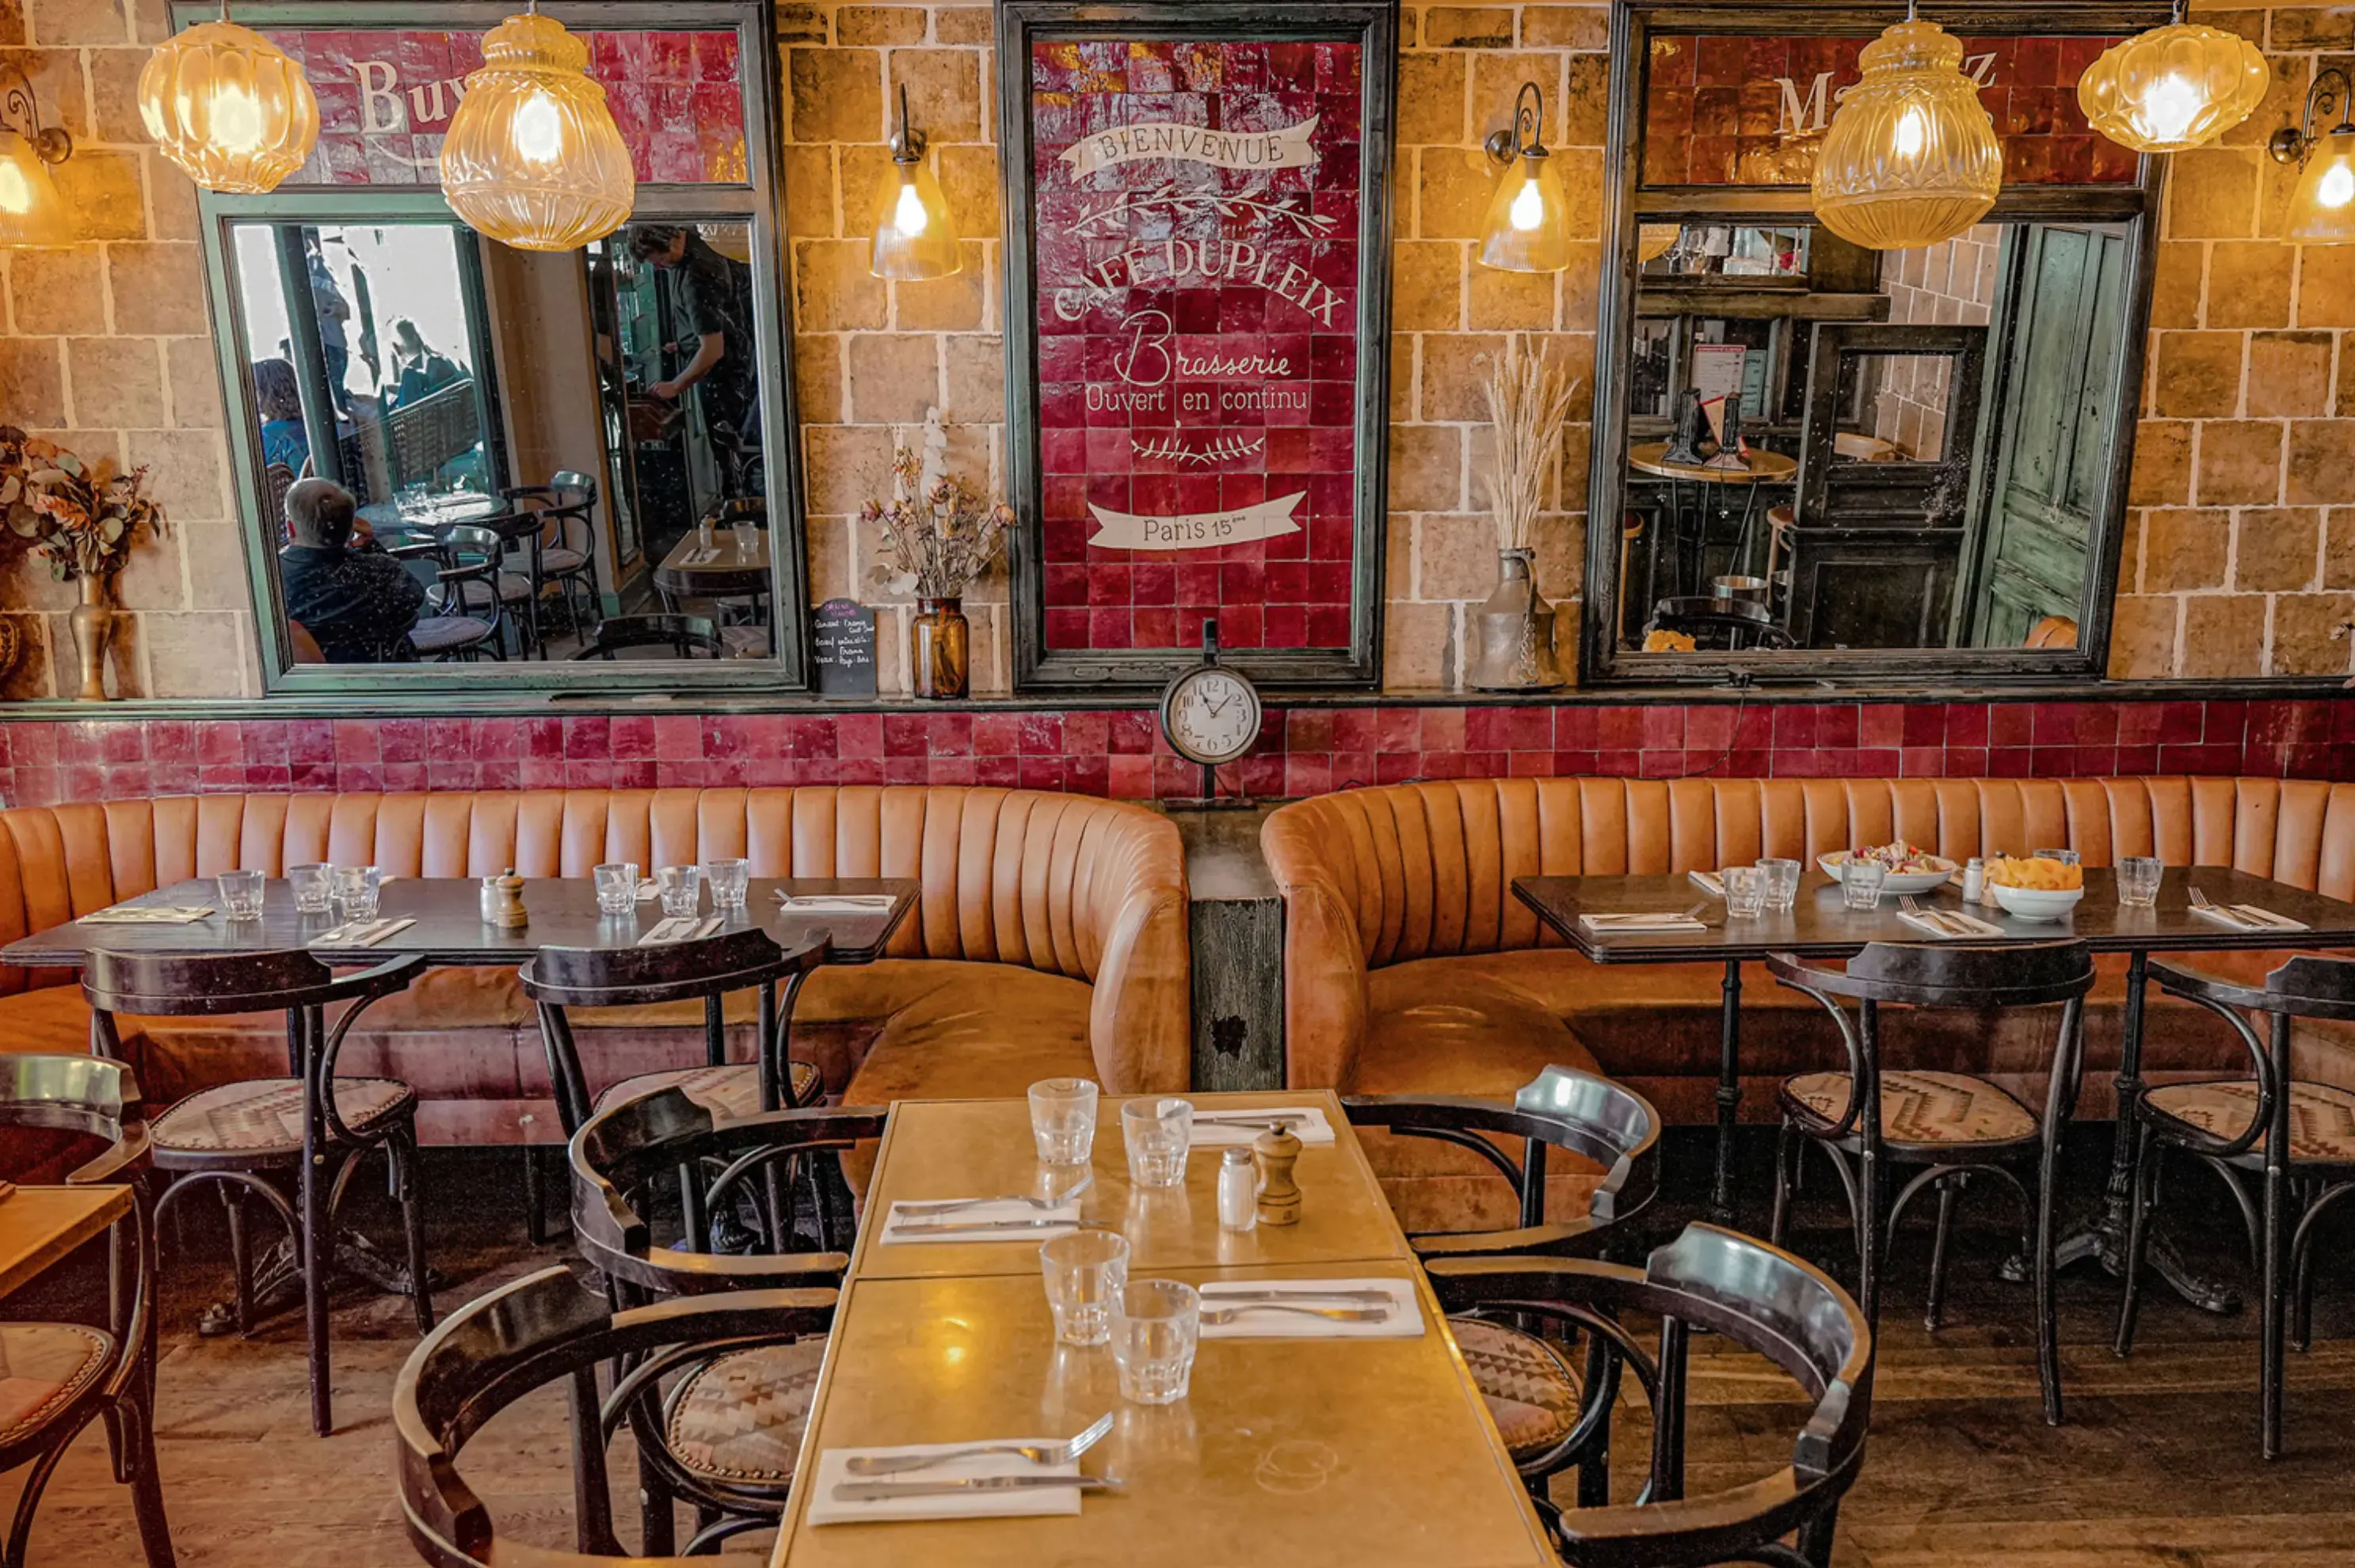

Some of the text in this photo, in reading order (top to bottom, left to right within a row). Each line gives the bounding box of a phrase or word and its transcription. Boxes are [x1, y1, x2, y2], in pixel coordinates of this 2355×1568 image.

[1098, 127, 1284, 166] BIENVENUE
[1164, 238, 1347, 329] DUPLEIX
[1114, 309, 1292, 387] Brasserie
[1085, 384, 1308, 411] Ouvert en continu
[1143, 519, 1206, 542] Paris
[1206, 680, 1219, 693] 12
[1183, 696, 1194, 708] 10
[1233, 693, 1243, 707] 2
[1236, 709, 1248, 723] 3
[1181, 724, 1193, 736] 8
[1206, 738, 1218, 751] 6
[1221, 734, 1233, 747] 5
